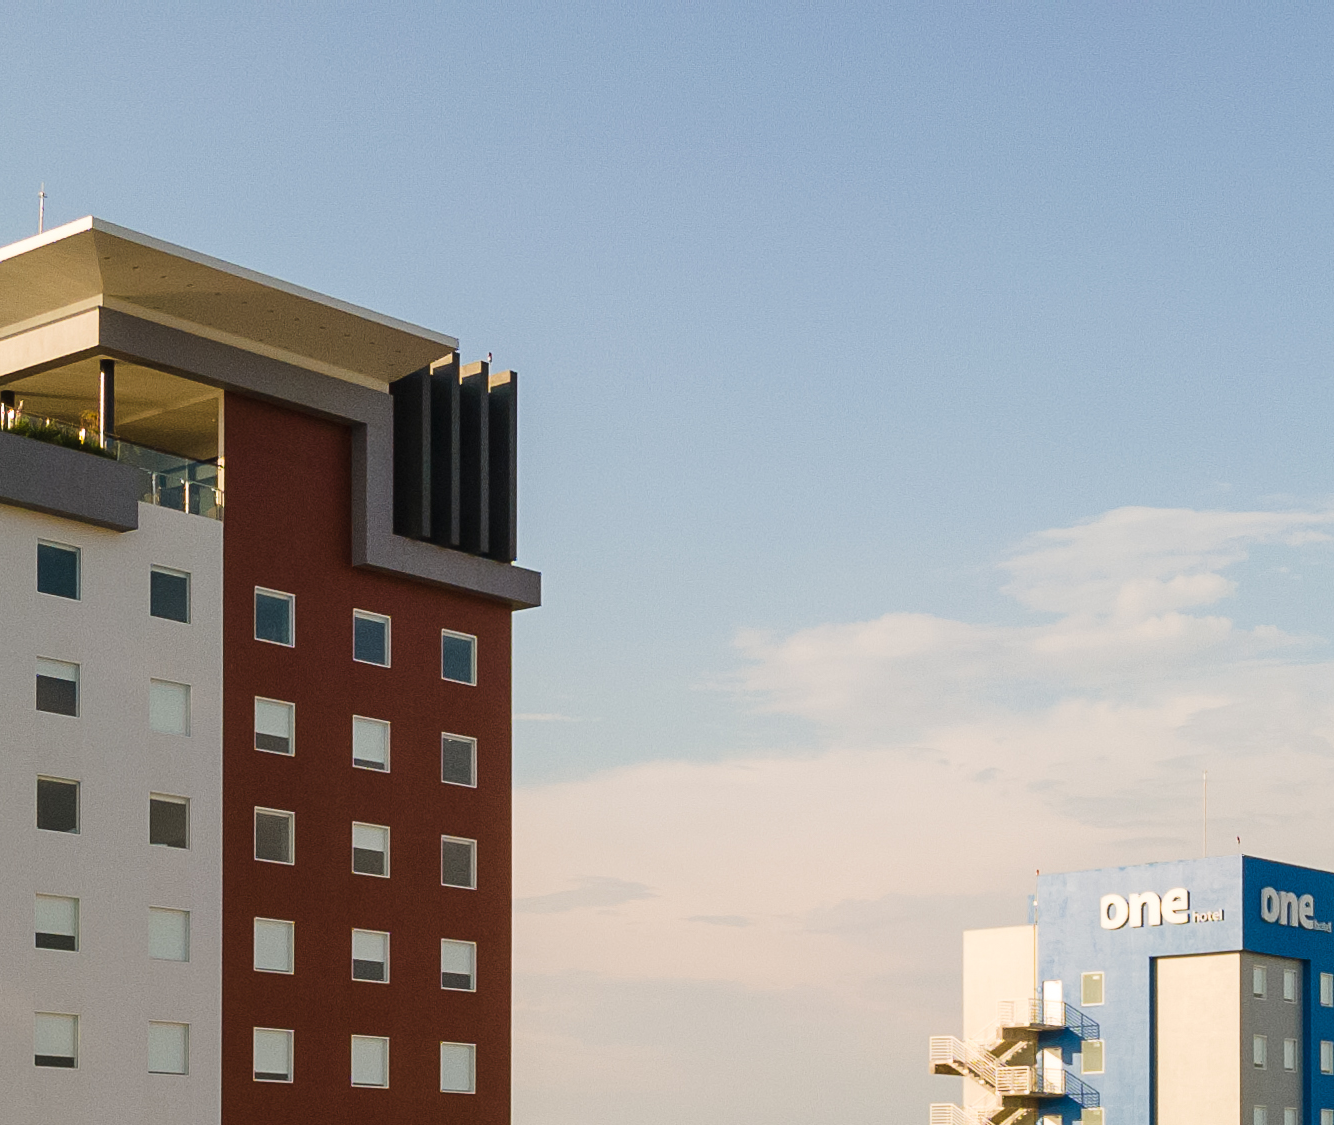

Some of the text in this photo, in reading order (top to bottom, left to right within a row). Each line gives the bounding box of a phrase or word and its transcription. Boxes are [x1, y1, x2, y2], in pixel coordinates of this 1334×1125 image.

[1100, 887, 1224, 930] one hotel
[1260, 886, 1315, 930] one
